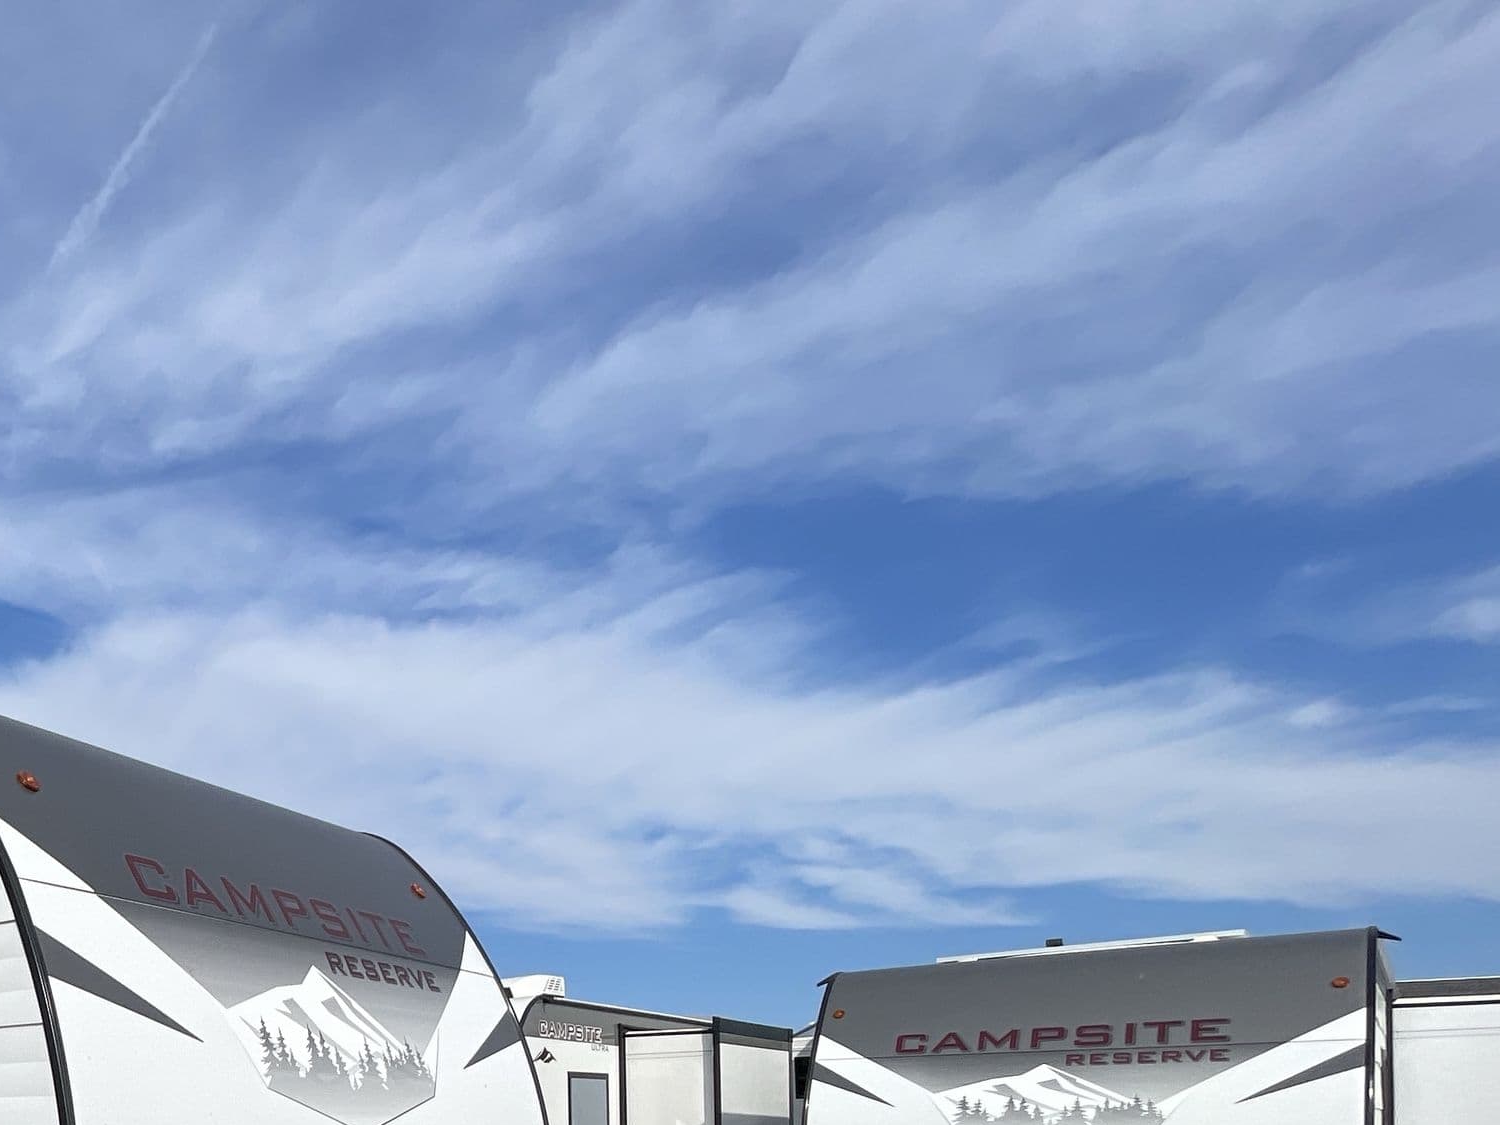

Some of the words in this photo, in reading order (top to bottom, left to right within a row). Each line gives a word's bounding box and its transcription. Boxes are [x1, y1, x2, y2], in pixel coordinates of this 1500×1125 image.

[124, 853, 427, 957] CAMPSITE
[324, 951, 442, 993] RESERVE
[538, 1020, 603, 1044] CAMPSITE
[894, 1018, 1232, 1055] CAMPSITE
[1065, 1049, 1232, 1067] RESERVE
